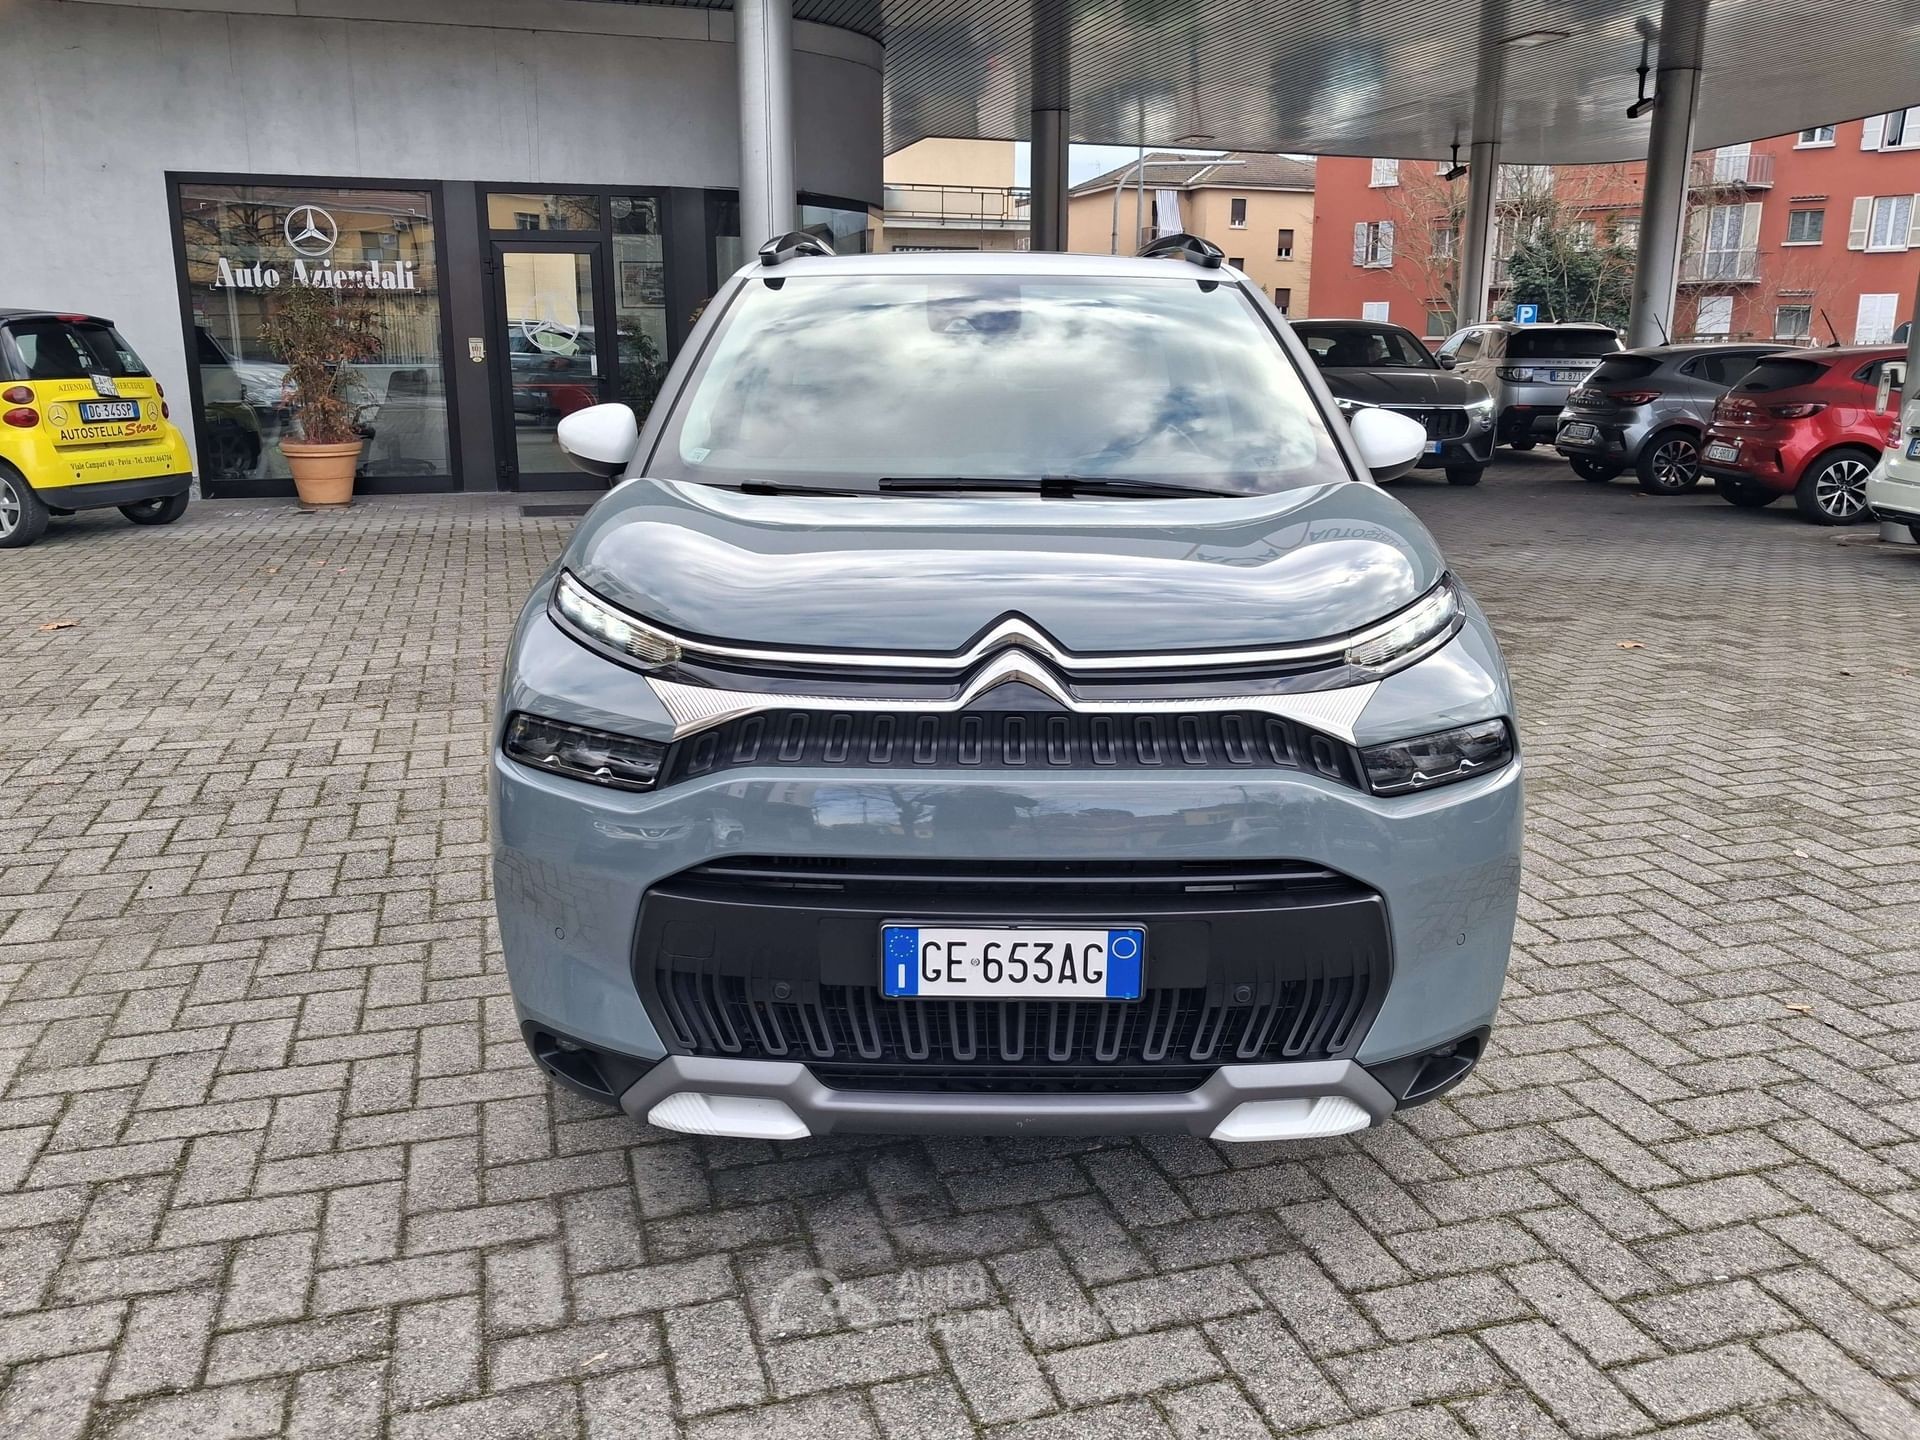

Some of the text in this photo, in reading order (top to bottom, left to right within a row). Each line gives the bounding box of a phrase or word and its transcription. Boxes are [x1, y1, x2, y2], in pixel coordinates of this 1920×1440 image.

[215, 257, 415, 290] Auto Aziendali
[1520, 306, 1533, 324] P
[88, 403, 101, 418] DG
[104, 403, 132, 418] 345SP
[61, 422, 158, 440] AUTOSTELLA Store
[921, 941, 967, 983] GE
[983, 941, 1103, 984] 653AG
